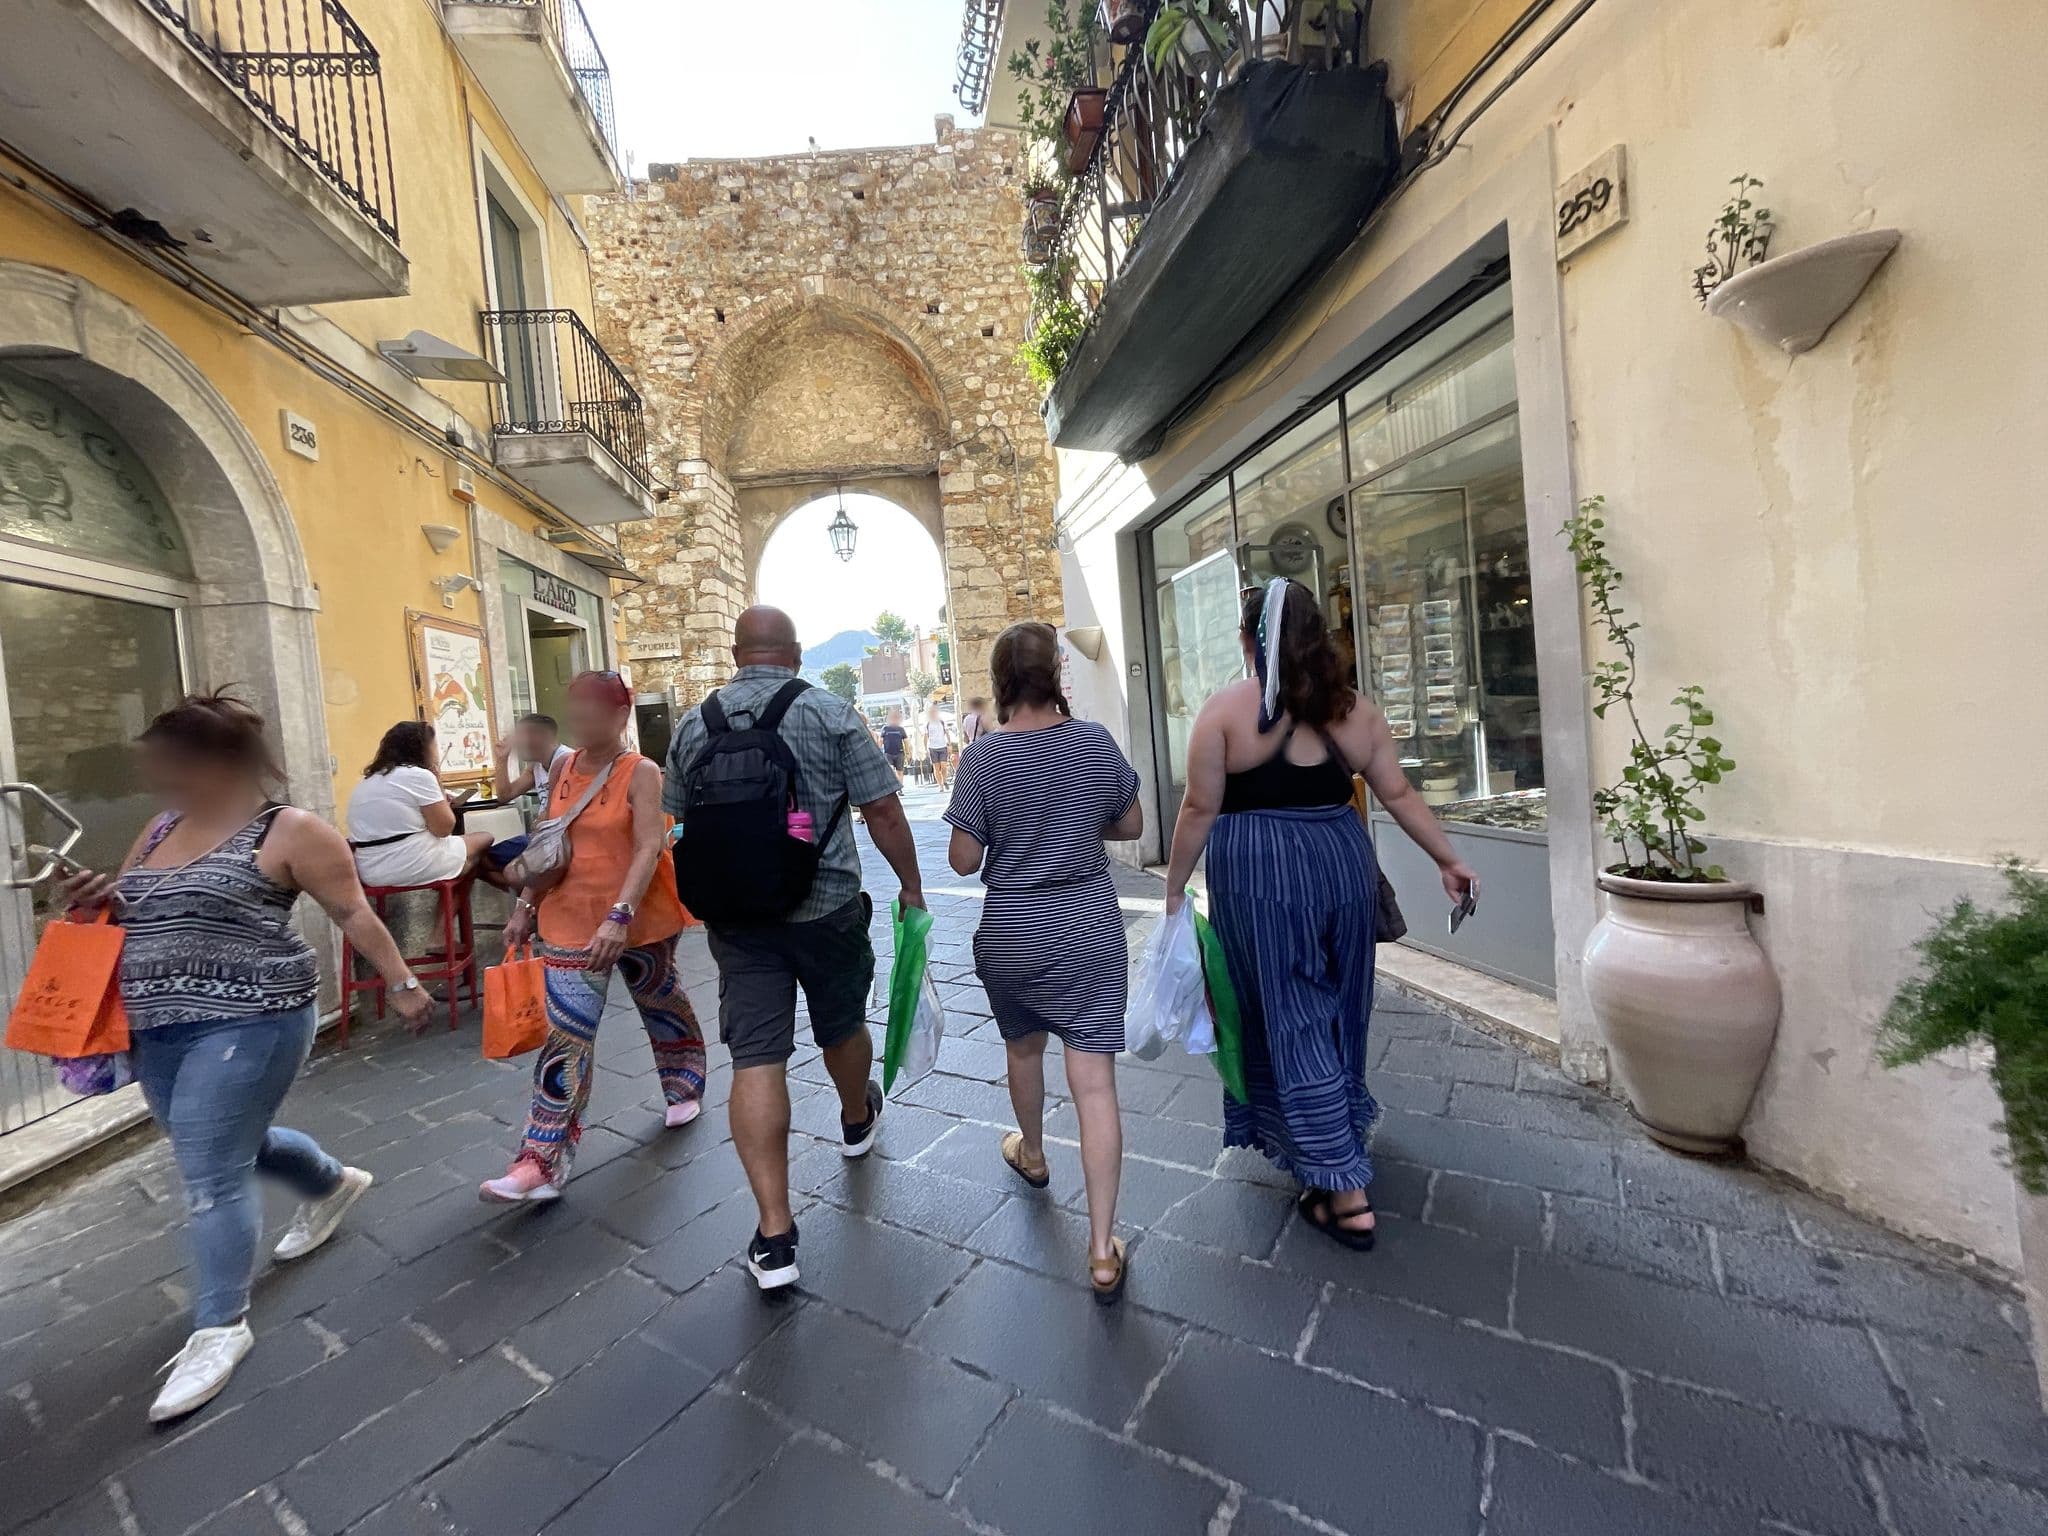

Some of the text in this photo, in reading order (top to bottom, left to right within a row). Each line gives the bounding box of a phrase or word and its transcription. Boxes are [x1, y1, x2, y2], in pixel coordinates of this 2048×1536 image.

[1558, 177, 1613, 238] 259
[291, 423, 316, 448] 238
[531, 569, 576, 608] L'Arco
